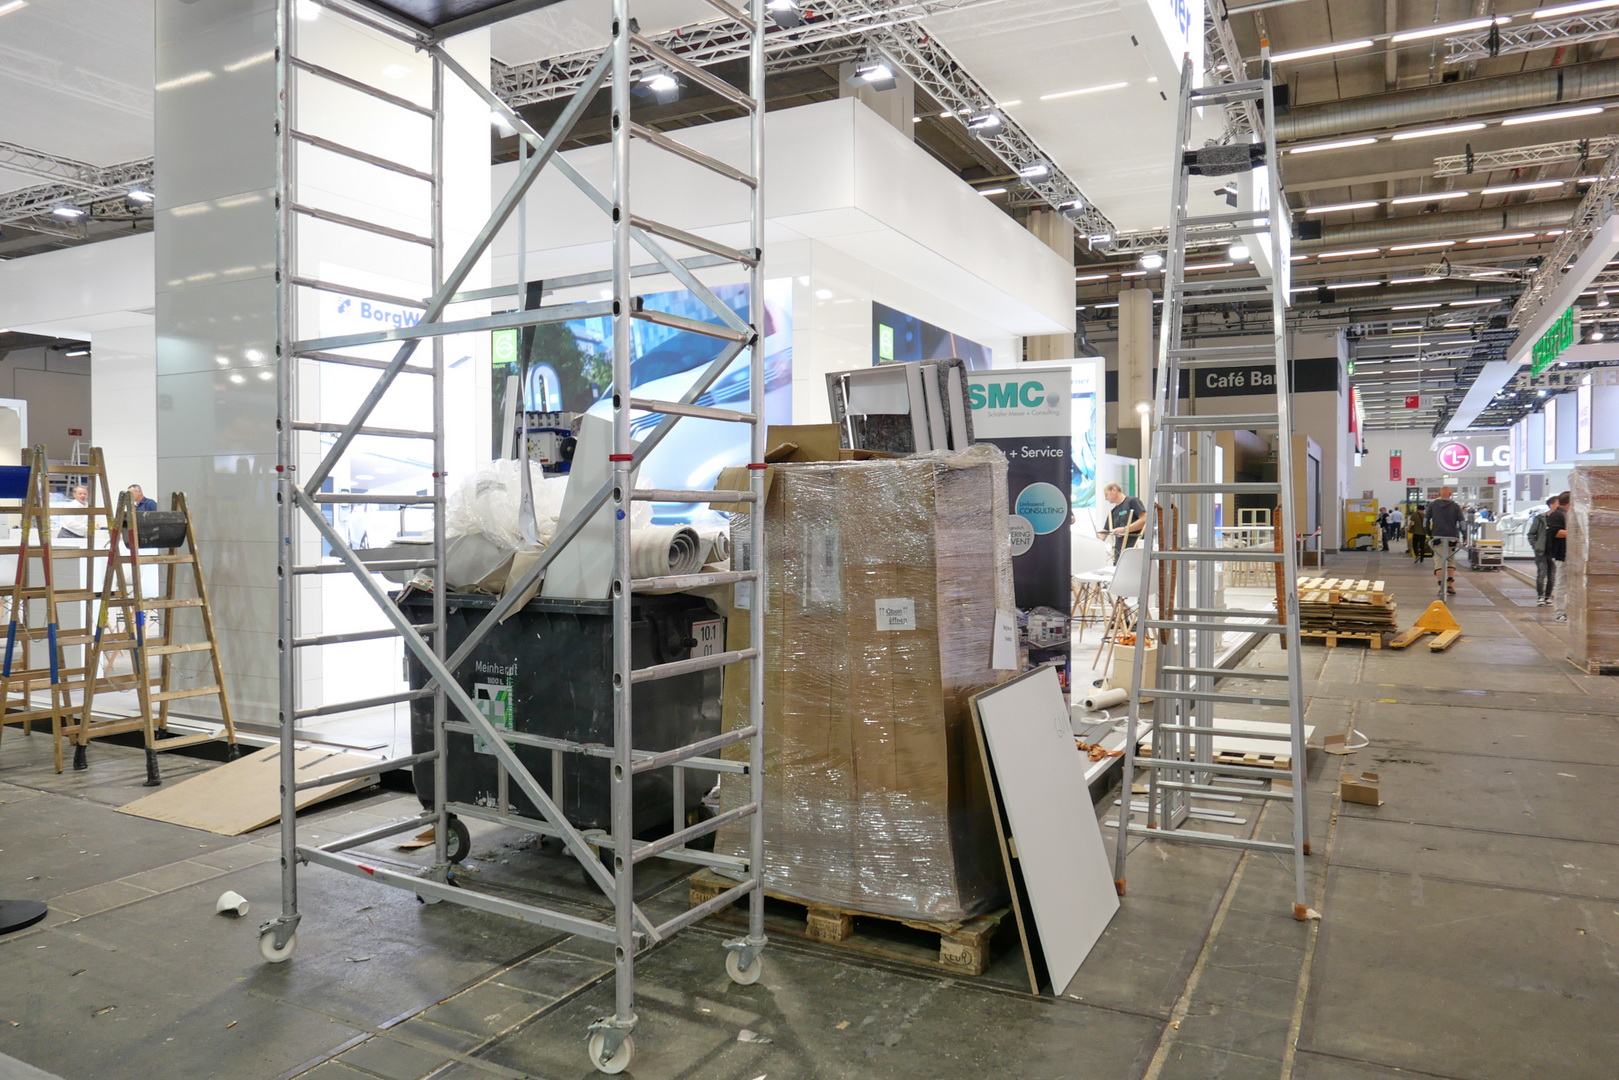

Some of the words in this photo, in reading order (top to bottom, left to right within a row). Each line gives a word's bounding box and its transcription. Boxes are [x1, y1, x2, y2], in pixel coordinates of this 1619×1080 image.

[1206, 371, 1245, 388] Café
[969, 381, 1045, 410] SMC
[1021, 446, 1064, 458] Service
[1476, 445, 1511, 467] LG
[1393, 468, 1400, 478] B
[1019, 507, 1065, 515] CONSULTING
[700, 625, 716, 641] 10.1
[475, 660, 518, 676] Meinhardt
